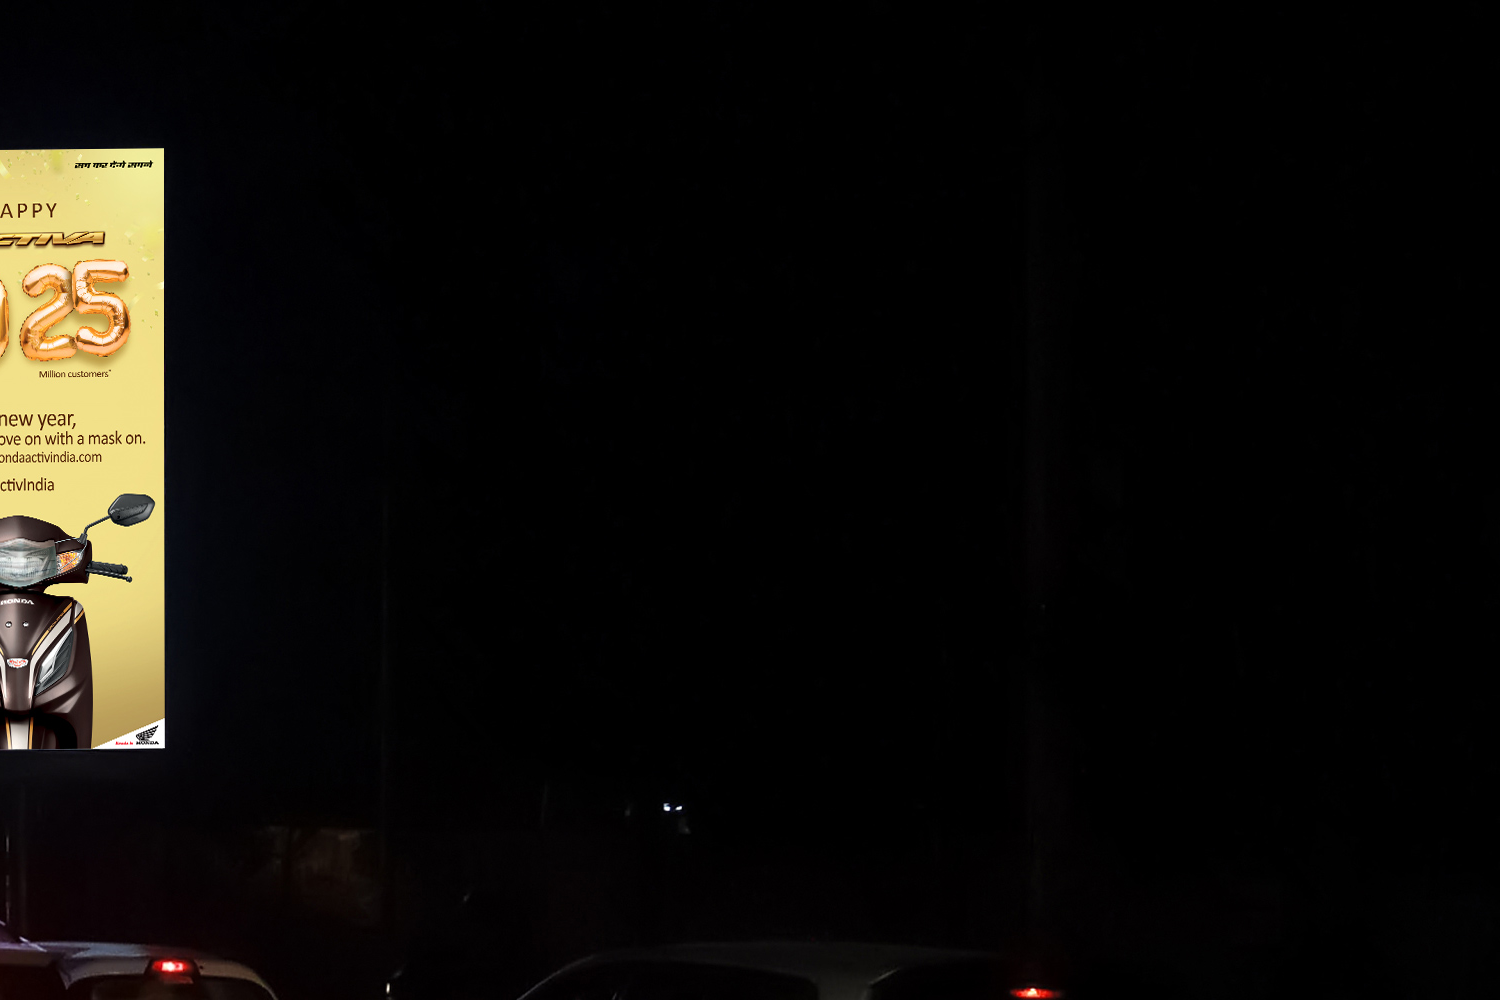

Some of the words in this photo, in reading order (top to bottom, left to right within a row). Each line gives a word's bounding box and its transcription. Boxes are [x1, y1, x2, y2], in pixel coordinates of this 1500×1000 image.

[39, 370, 66, 378] Million
[38, 413, 76, 431] year,
[24, 434, 41, 446] on
[45, 431, 73, 446] with
[77, 434, 85, 445] a
[88, 430, 122, 445] mask
[125, 434, 146, 445] on.
